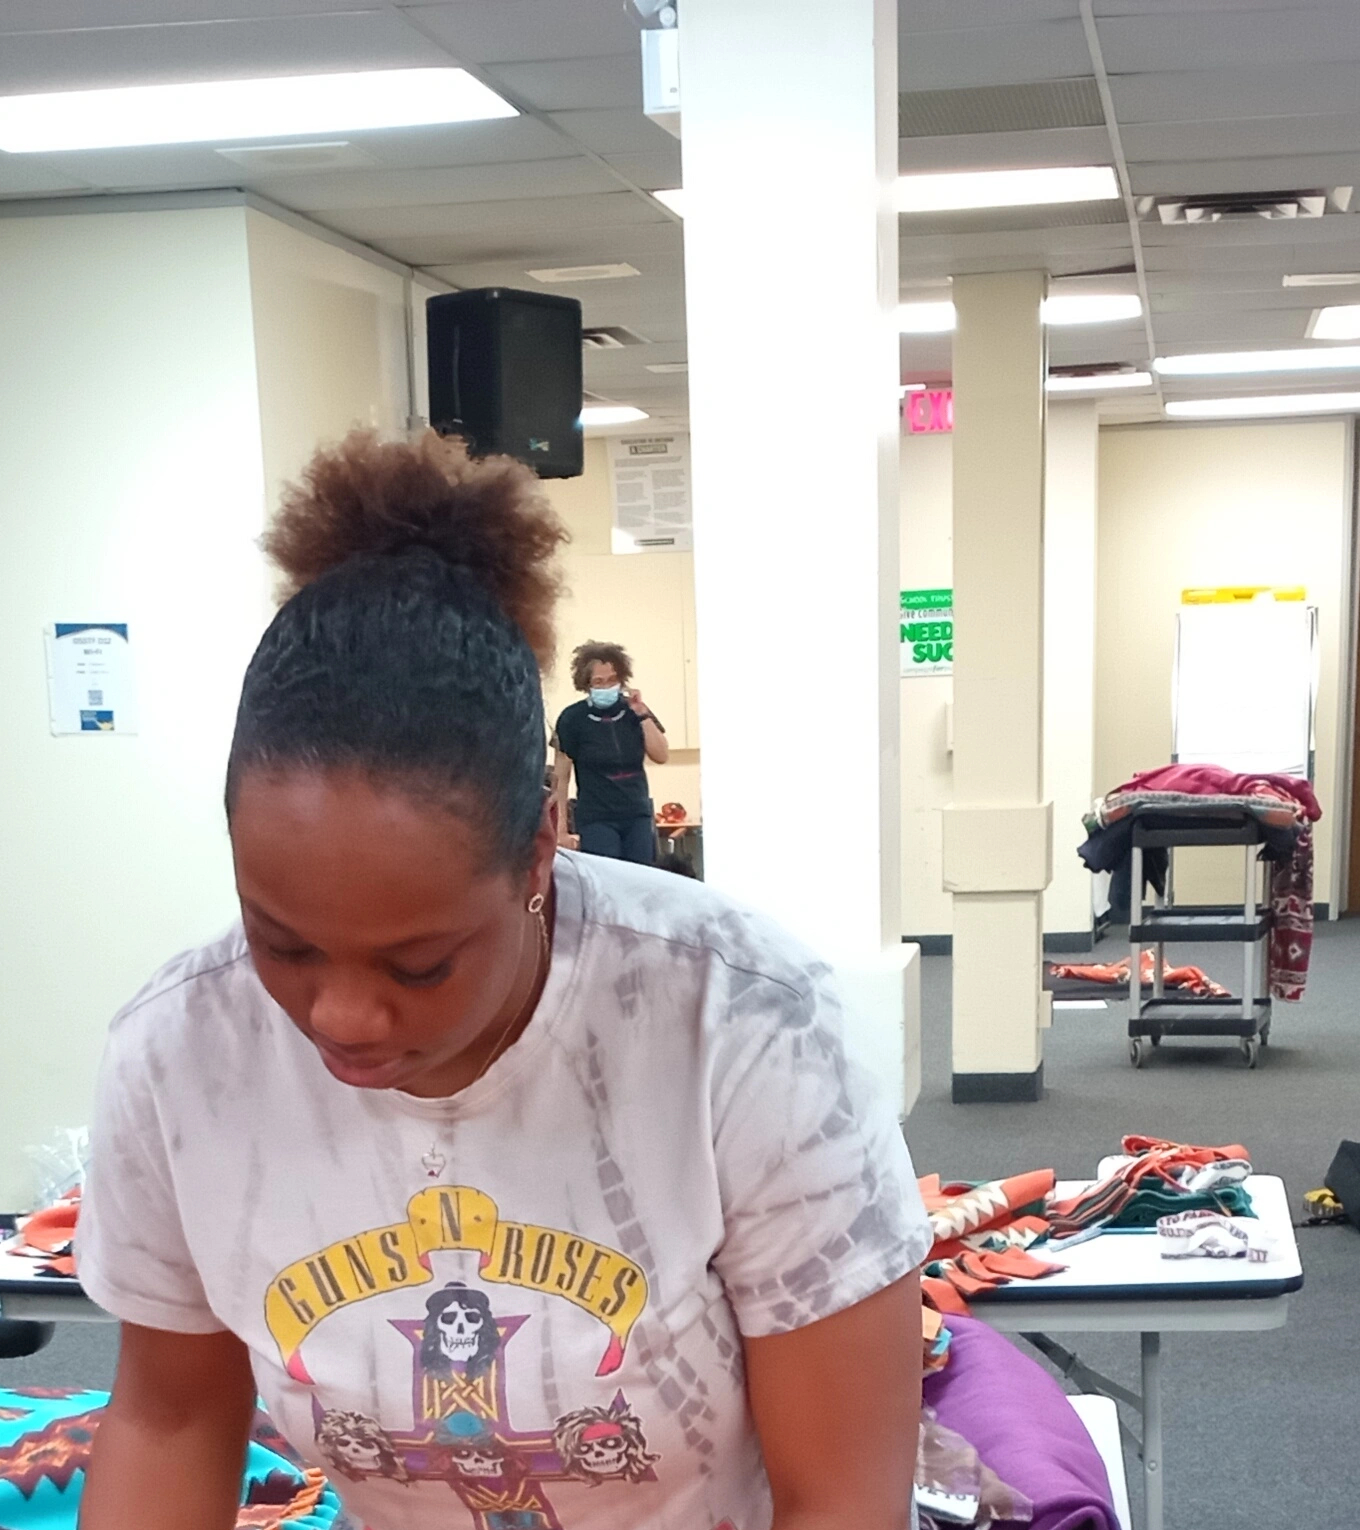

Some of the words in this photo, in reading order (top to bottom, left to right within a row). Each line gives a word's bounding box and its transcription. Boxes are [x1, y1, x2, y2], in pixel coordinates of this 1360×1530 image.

[900, 621, 953, 643] NEED
[276, 1230, 410, 1327] GUNS
[438, 1191, 463, 1243] N
[498, 1225, 640, 1318] ROSES
